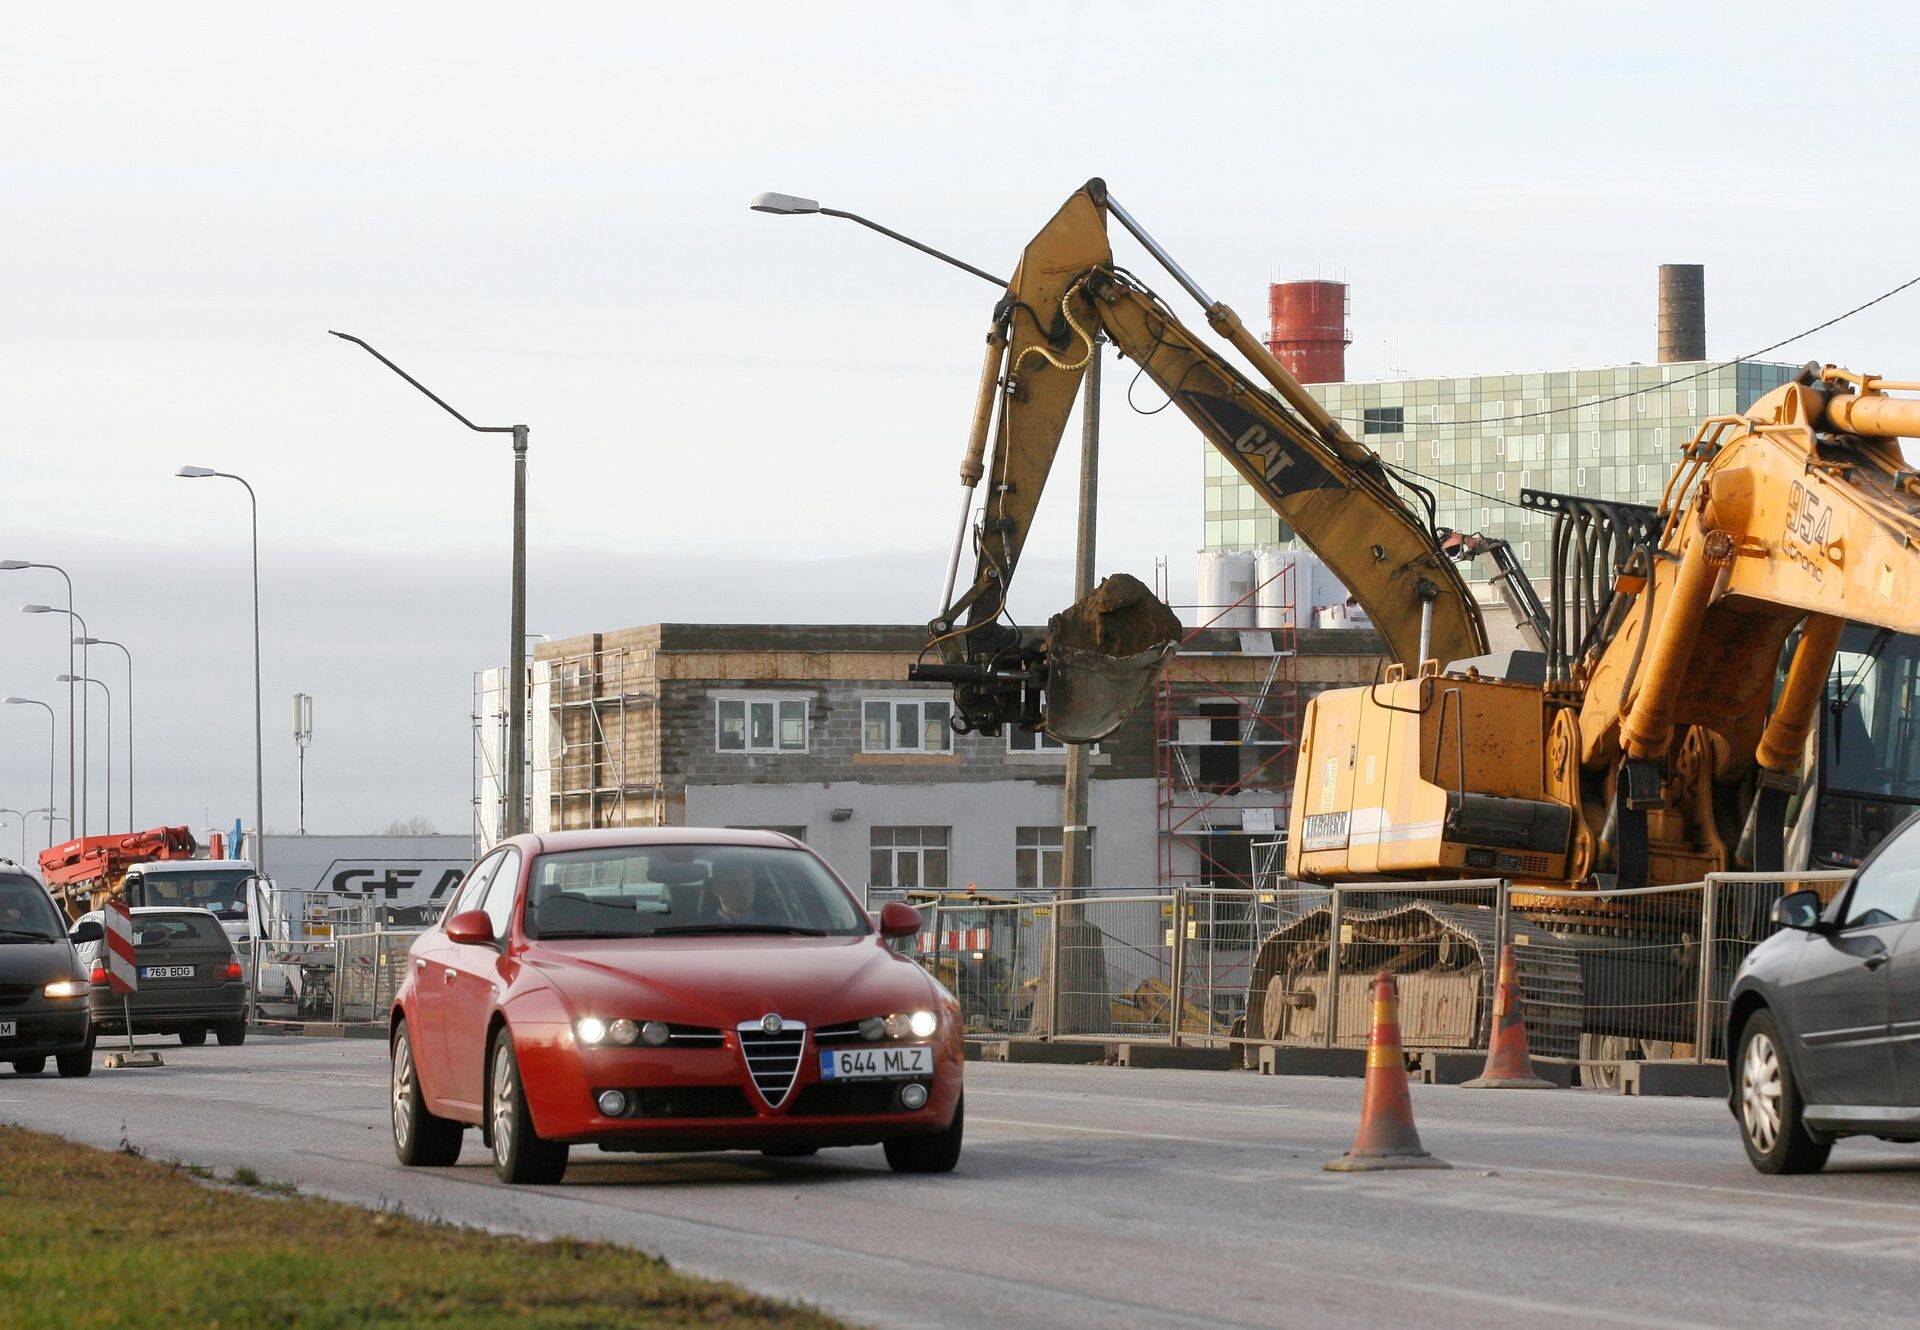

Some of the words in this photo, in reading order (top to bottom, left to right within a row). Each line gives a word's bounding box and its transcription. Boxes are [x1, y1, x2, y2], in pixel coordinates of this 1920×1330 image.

[1236, 424, 1295, 481] CAT
[1786, 479, 1833, 557] 954
[150, 968, 167, 977] 769
[170, 967, 190, 976] BDG
[841, 1053, 876, 1074] 644
[884, 1050, 923, 1072] MLZ
